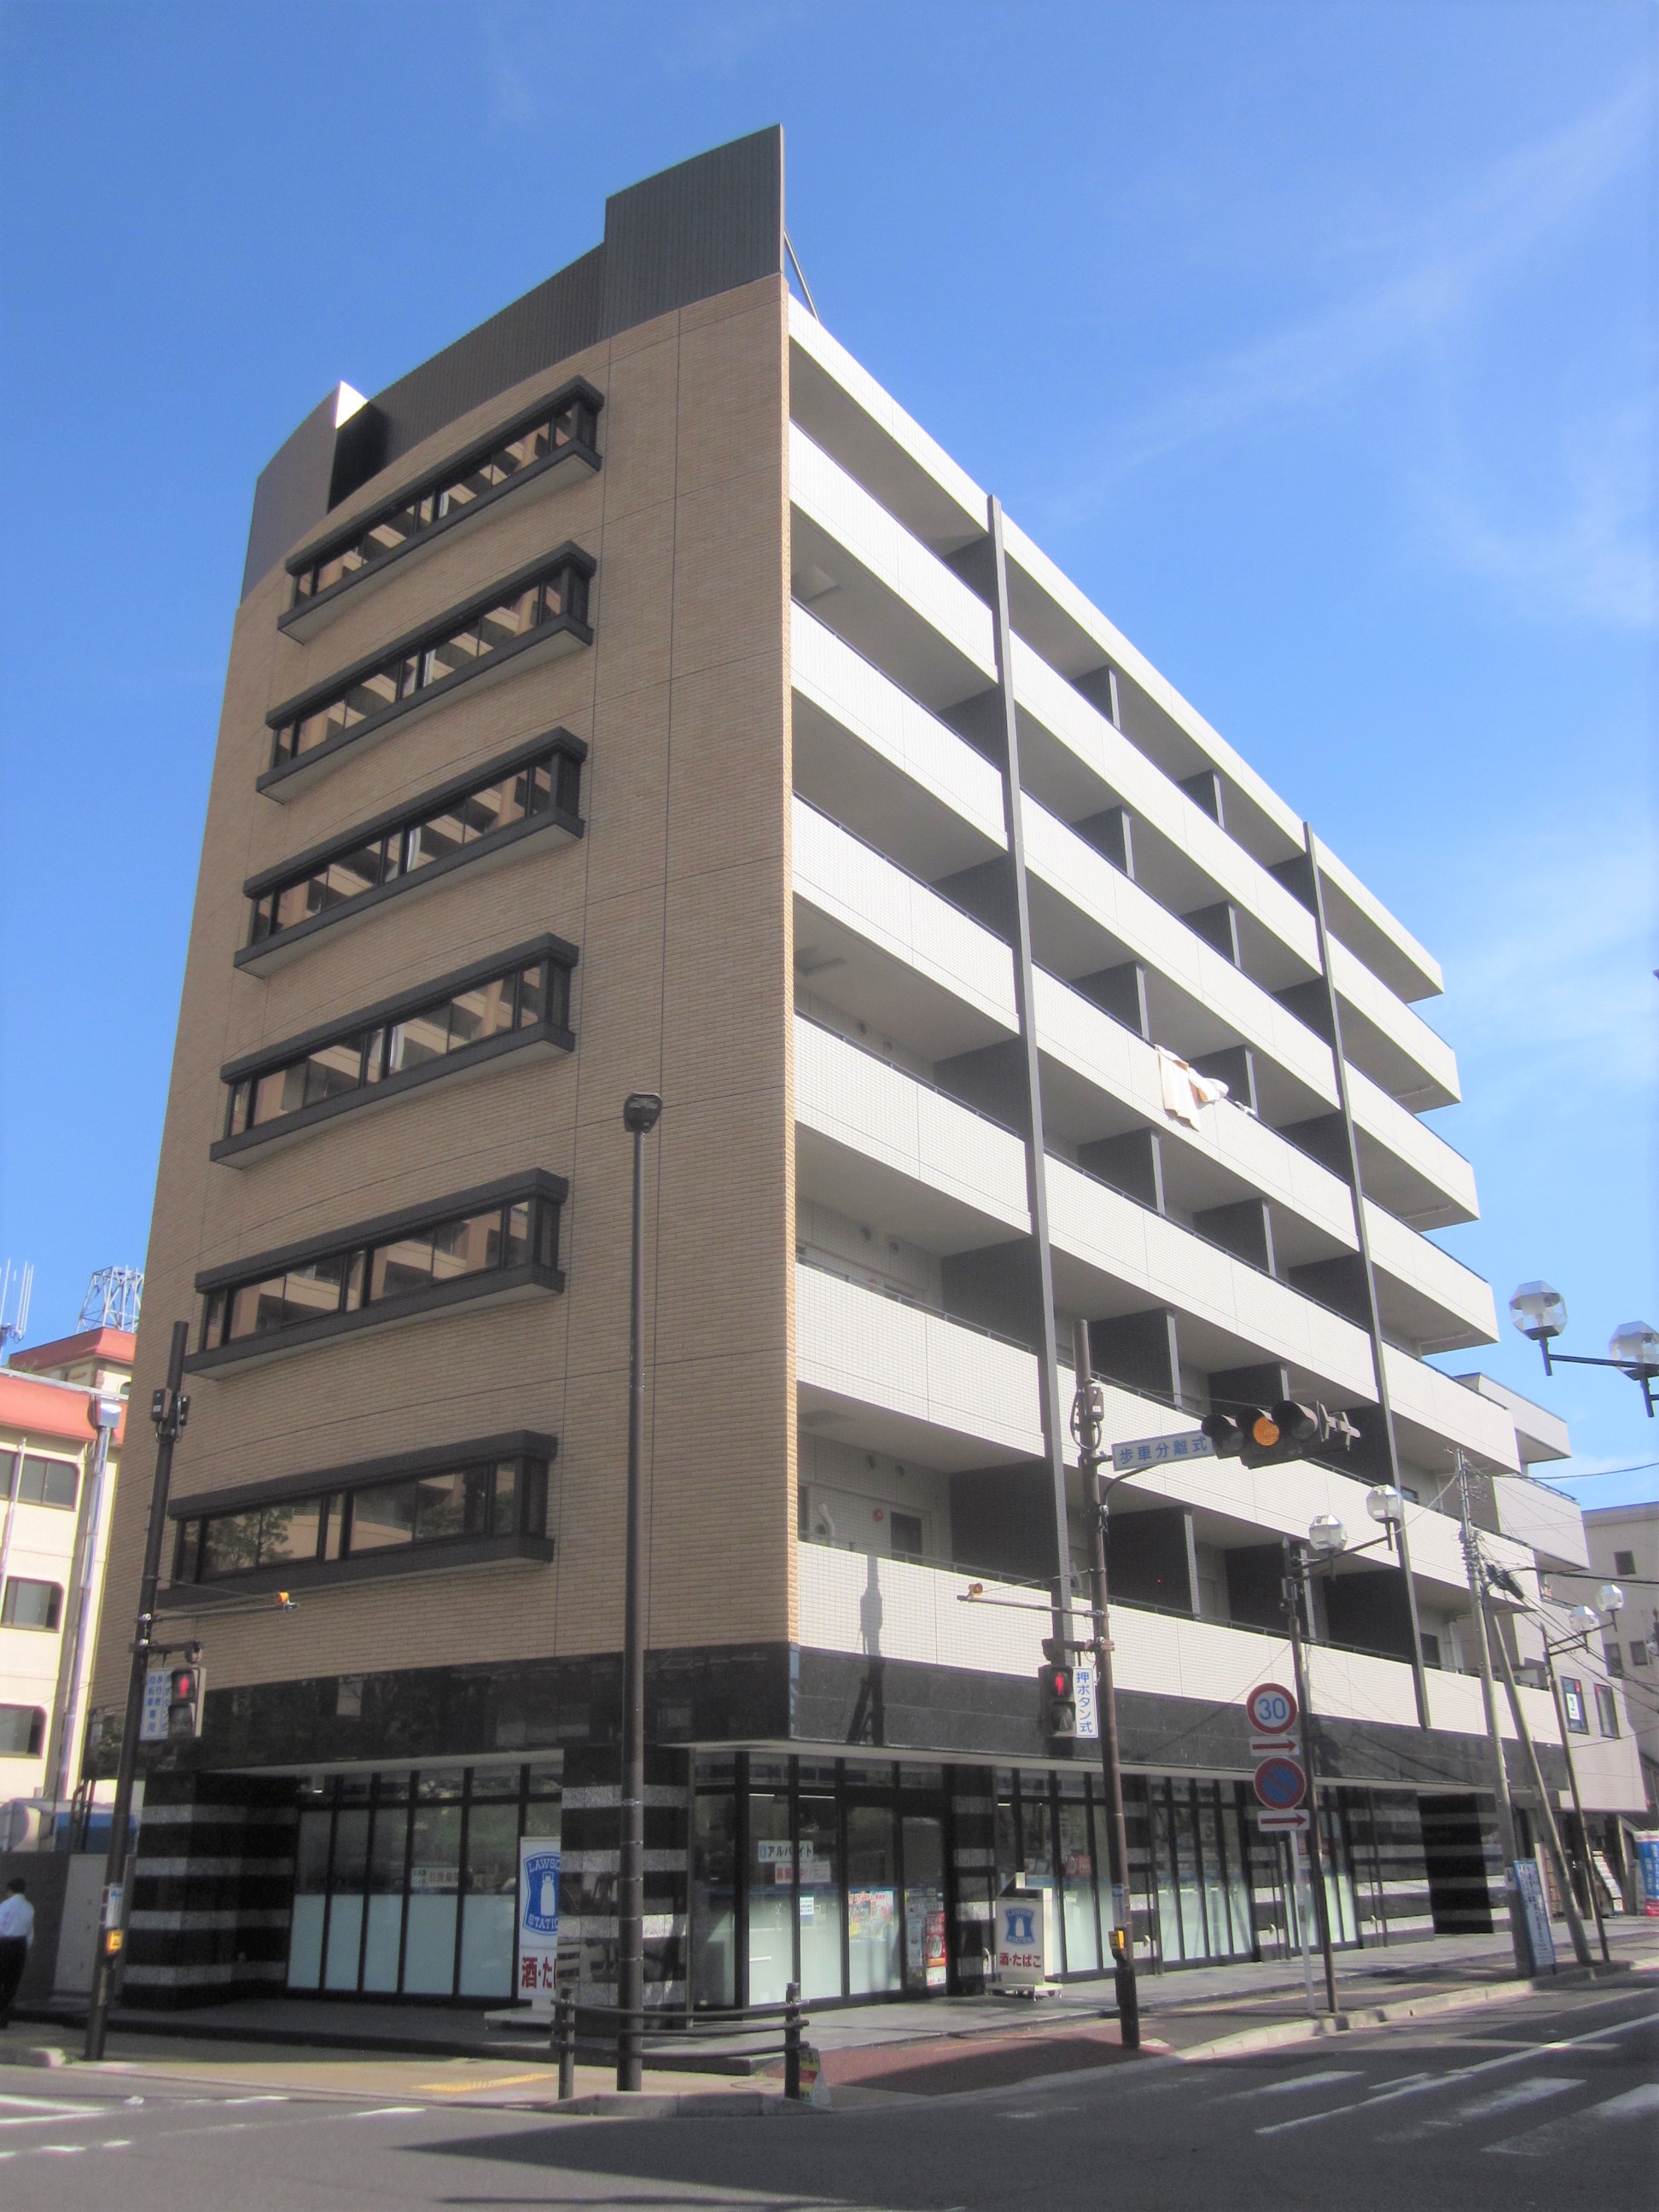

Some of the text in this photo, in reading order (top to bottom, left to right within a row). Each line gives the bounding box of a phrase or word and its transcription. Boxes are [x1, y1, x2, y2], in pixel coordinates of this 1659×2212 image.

[1119, 1435, 1208, 1464] 歩車分離式
[1075, 1671, 1092, 1733] 押ボタン式
[1258, 1697, 1287, 1720] 30
[528, 1857, 561, 1872] LAWSO
[521, 1956, 557, 1989] 酒・た
